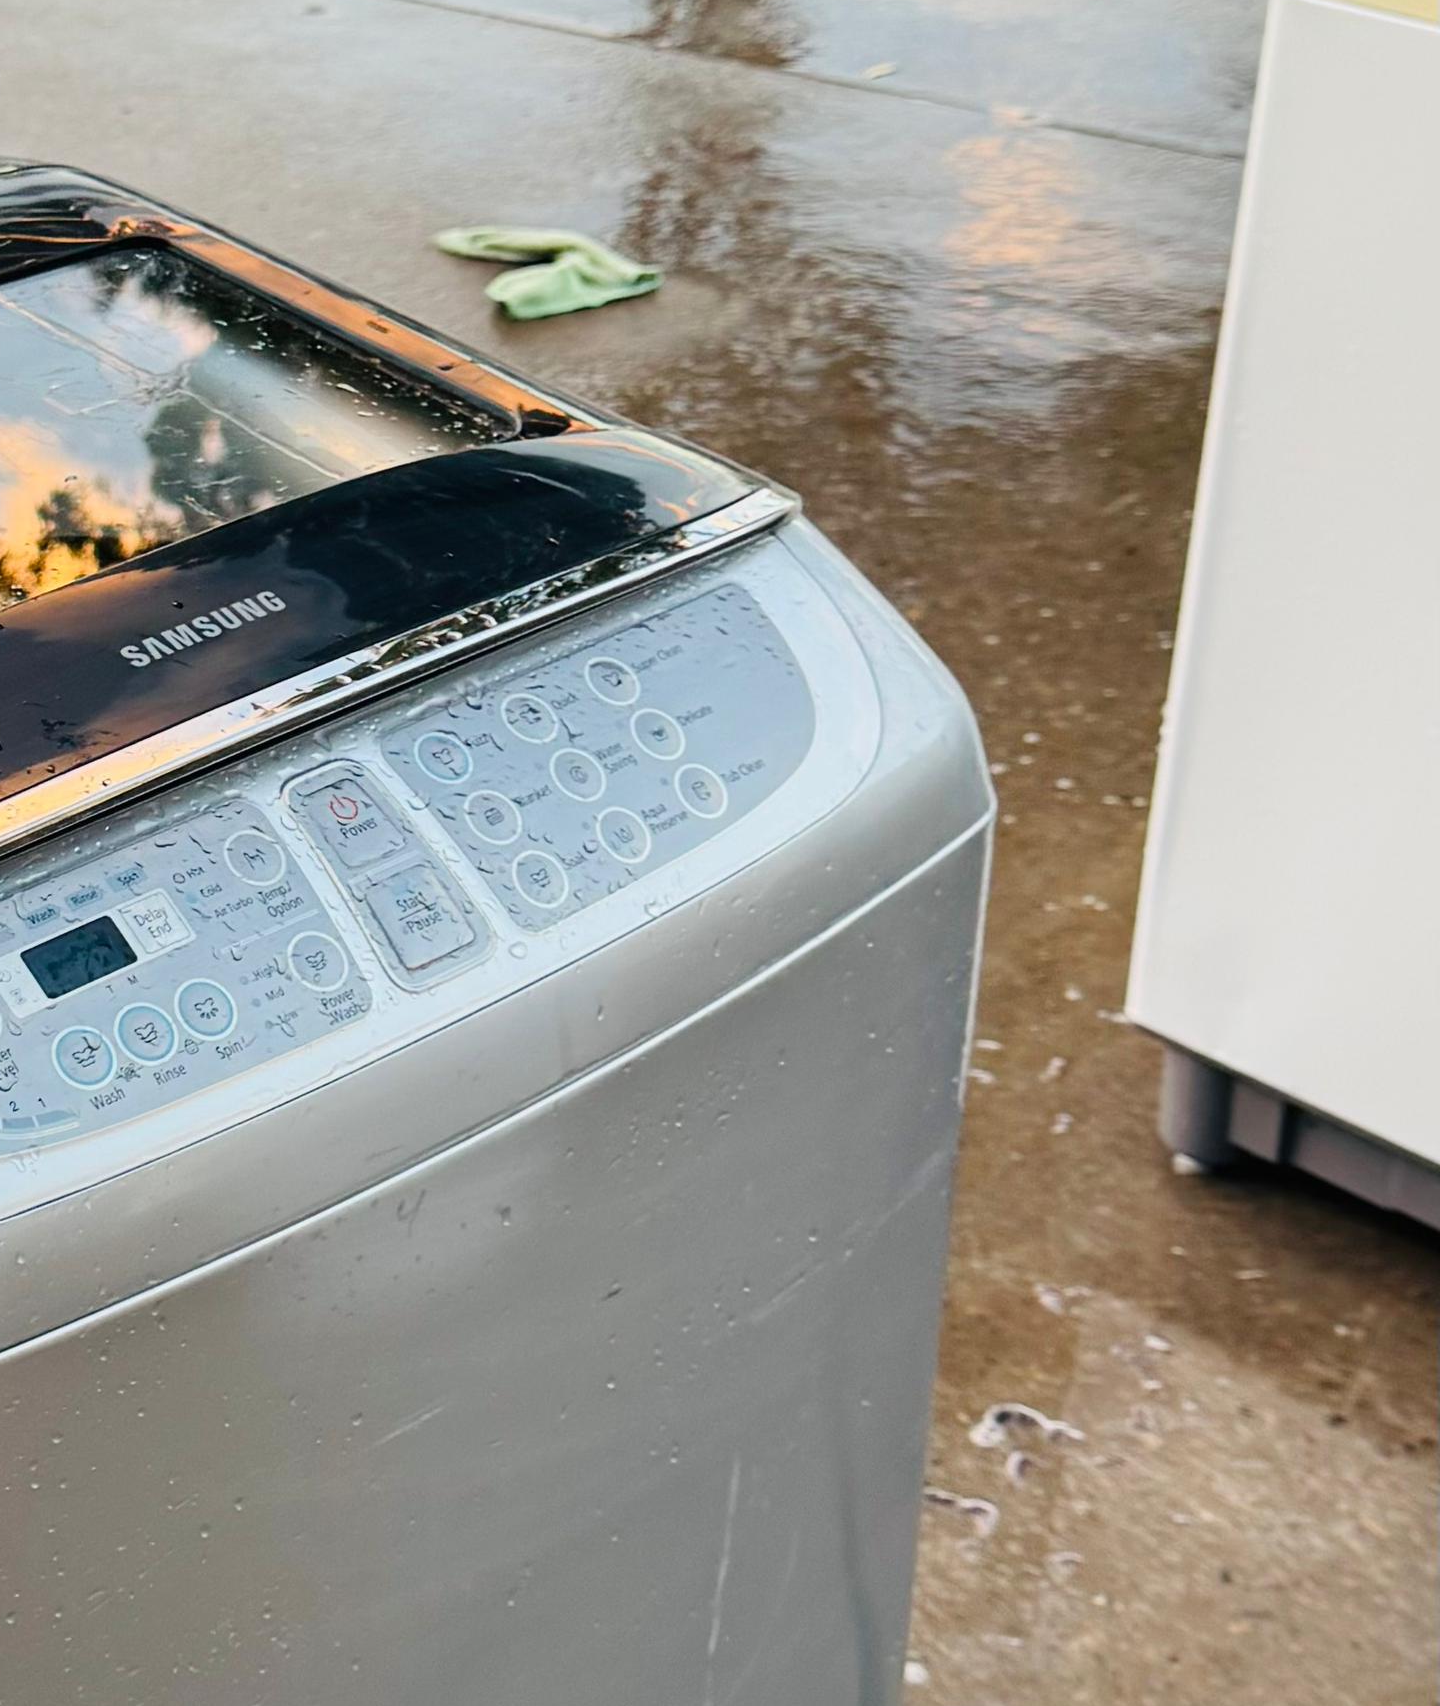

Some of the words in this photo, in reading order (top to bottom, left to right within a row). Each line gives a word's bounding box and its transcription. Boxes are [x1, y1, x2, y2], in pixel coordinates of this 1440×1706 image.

[119, 590, 287, 668] SAMSUNG
[656, 644, 684, 661] Clean
[675, 705, 713, 726] Delicate
[594, 743, 623, 761] Water
[603, 754, 638, 775] Saving
[737, 759, 766, 777] Clean
[640, 803, 667, 820] Aqua
[339, 817, 378, 840] Power
[649, 811, 689, 836] Preserve
[70, 891, 97, 908] Rinse
[267, 895, 305, 918] Option
[396, 894, 427, 914] Start
[27, 907, 57, 926] Wash
[133, 909, 168, 927] Delay
[405, 912, 443, 934] Pause
[147, 921, 173, 939] End
[264, 986, 285, 1000] Mid
[320, 988, 355, 1010] Power
[329, 1004, 364, 1026] Wash
[215, 1040, 244, 1060] Spin
[152, 1063, 188, 1086] Rinse
[8, 1100, 20, 1113] 2
[38, 1097, 47, 1108] 1
[89, 1086, 127, 1111] Wash
